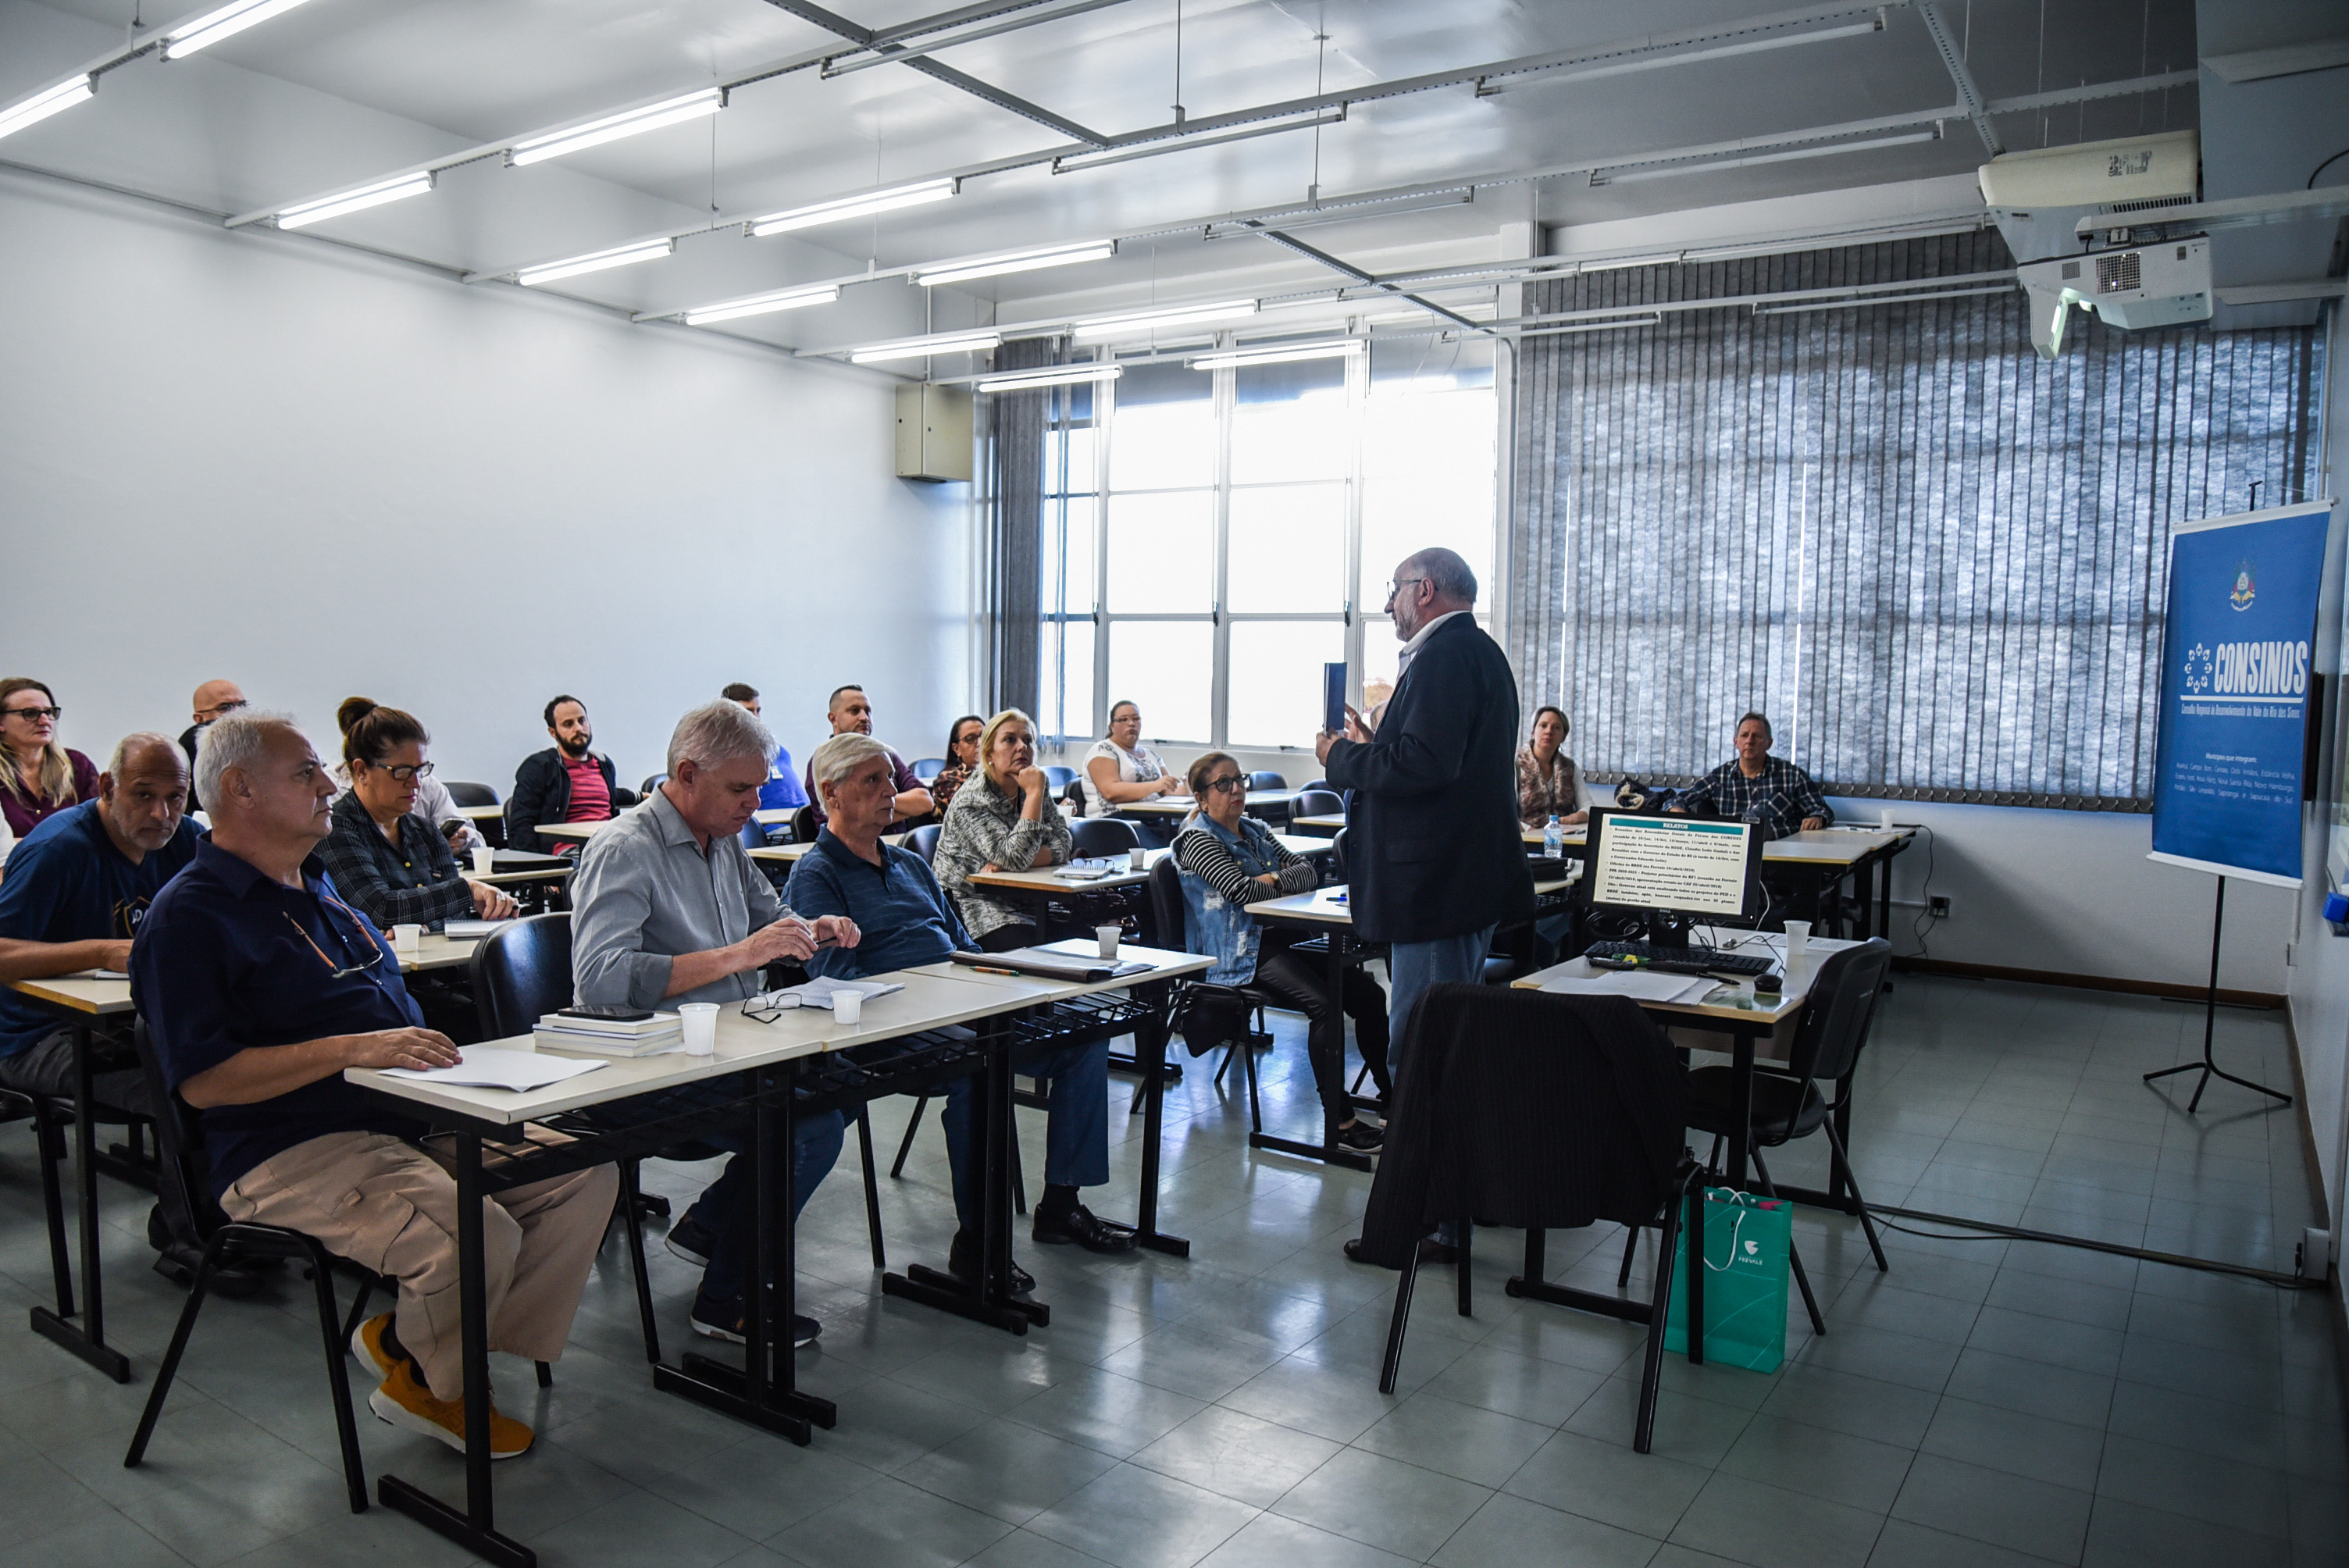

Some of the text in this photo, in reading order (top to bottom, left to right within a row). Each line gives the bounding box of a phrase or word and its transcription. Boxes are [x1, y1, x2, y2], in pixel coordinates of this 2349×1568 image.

[2215, 640, 2308, 693] CONSINOS
[2196, 704, 2210, 716] Regional
[2215, 704, 2245, 716] Desenvolvimento
[2253, 706, 2262, 717] Vale
[2287, 707, 2300, 718] Sinos
[1738, 1256, 1763, 1265] FEEVALE
